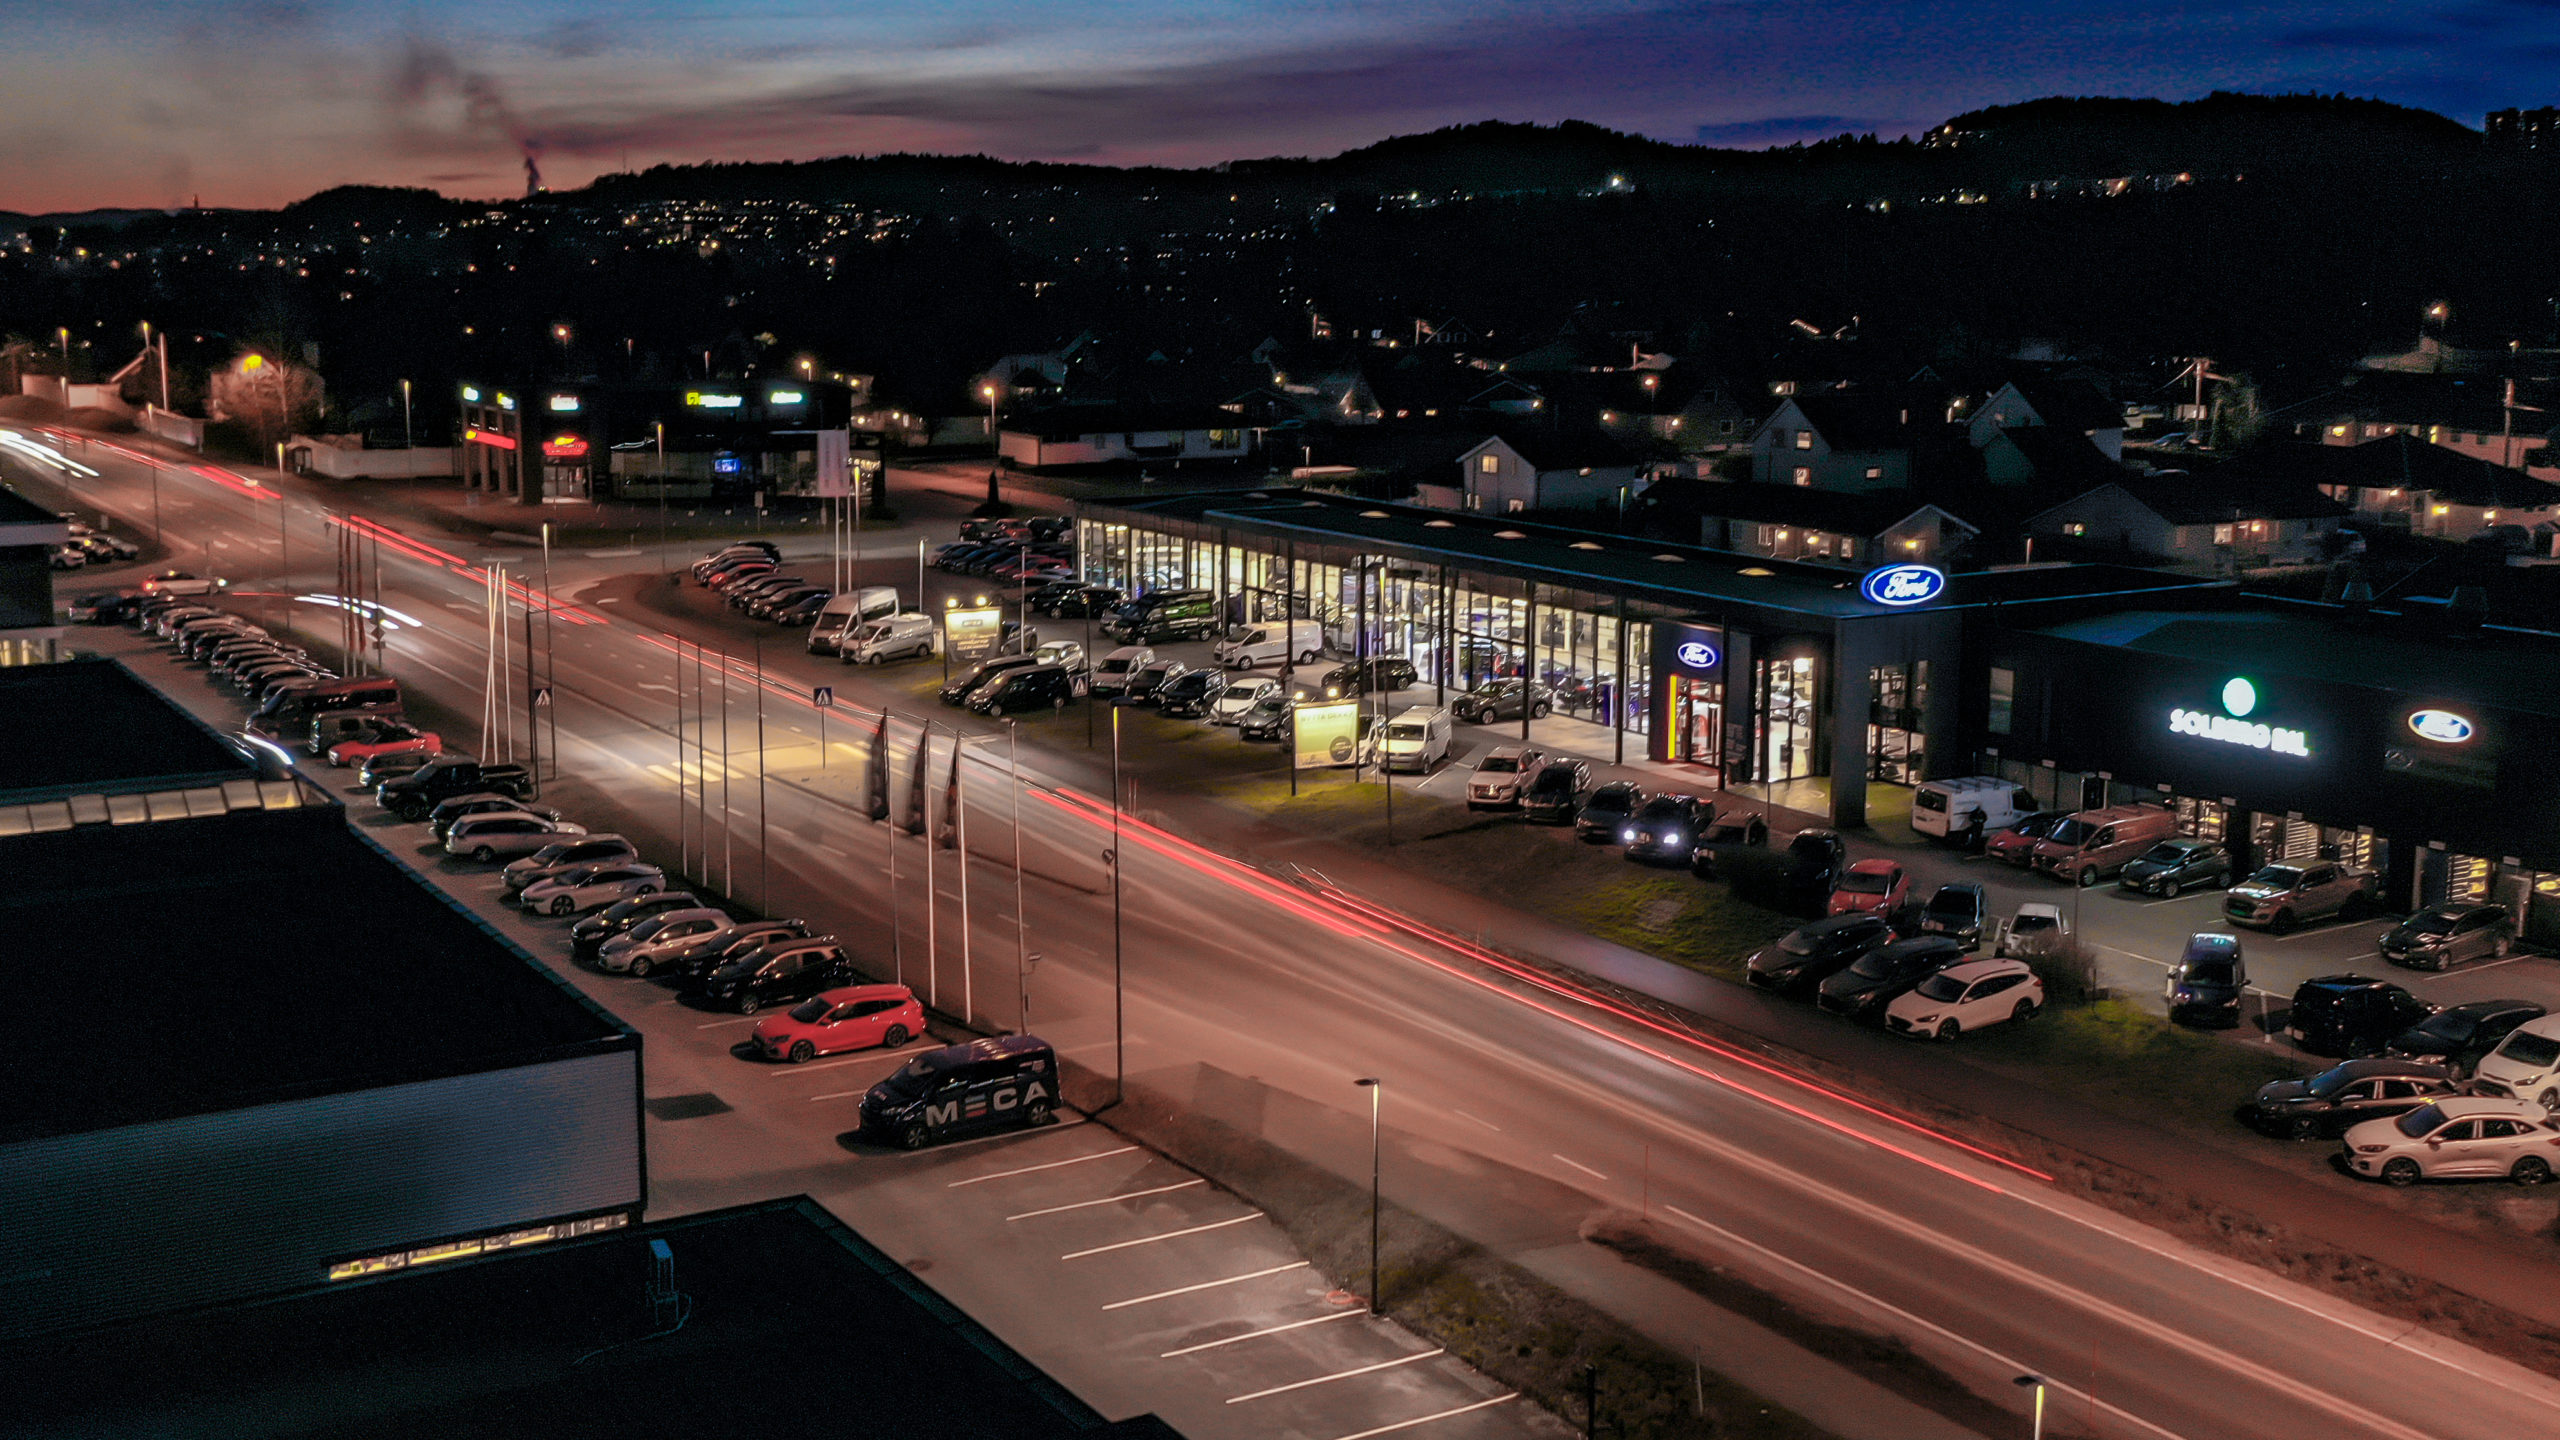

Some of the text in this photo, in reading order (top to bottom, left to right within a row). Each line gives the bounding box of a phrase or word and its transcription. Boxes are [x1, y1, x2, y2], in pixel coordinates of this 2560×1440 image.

[1884, 571, 1931, 599] Ford
[1683, 645, 1709, 664] Ford
[926, 1081, 1049, 1128] MECA
